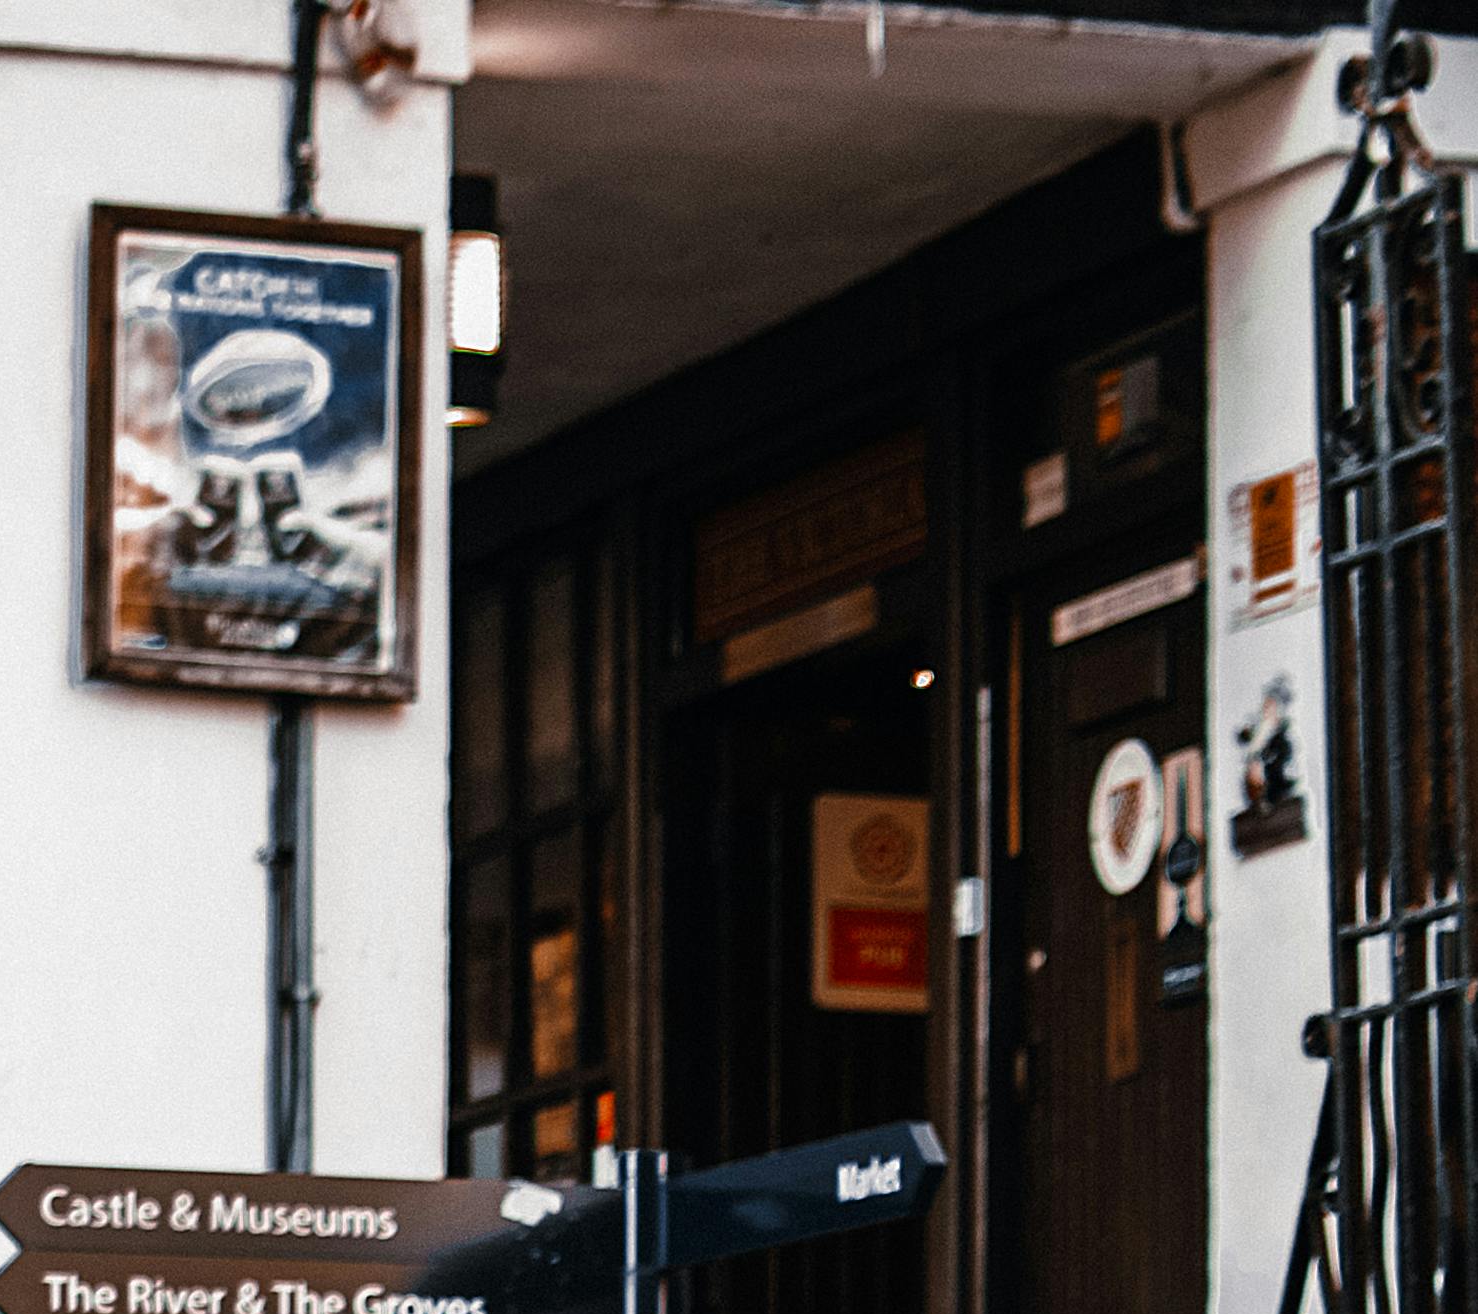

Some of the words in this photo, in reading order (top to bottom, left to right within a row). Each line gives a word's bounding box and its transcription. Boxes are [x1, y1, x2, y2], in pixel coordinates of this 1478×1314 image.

[39, 1185, 161, 1231] Castle
[169, 1193, 200, 1231] &
[209, 1195, 399, 1240] Museums
[43, 1272, 118, 1314] The
